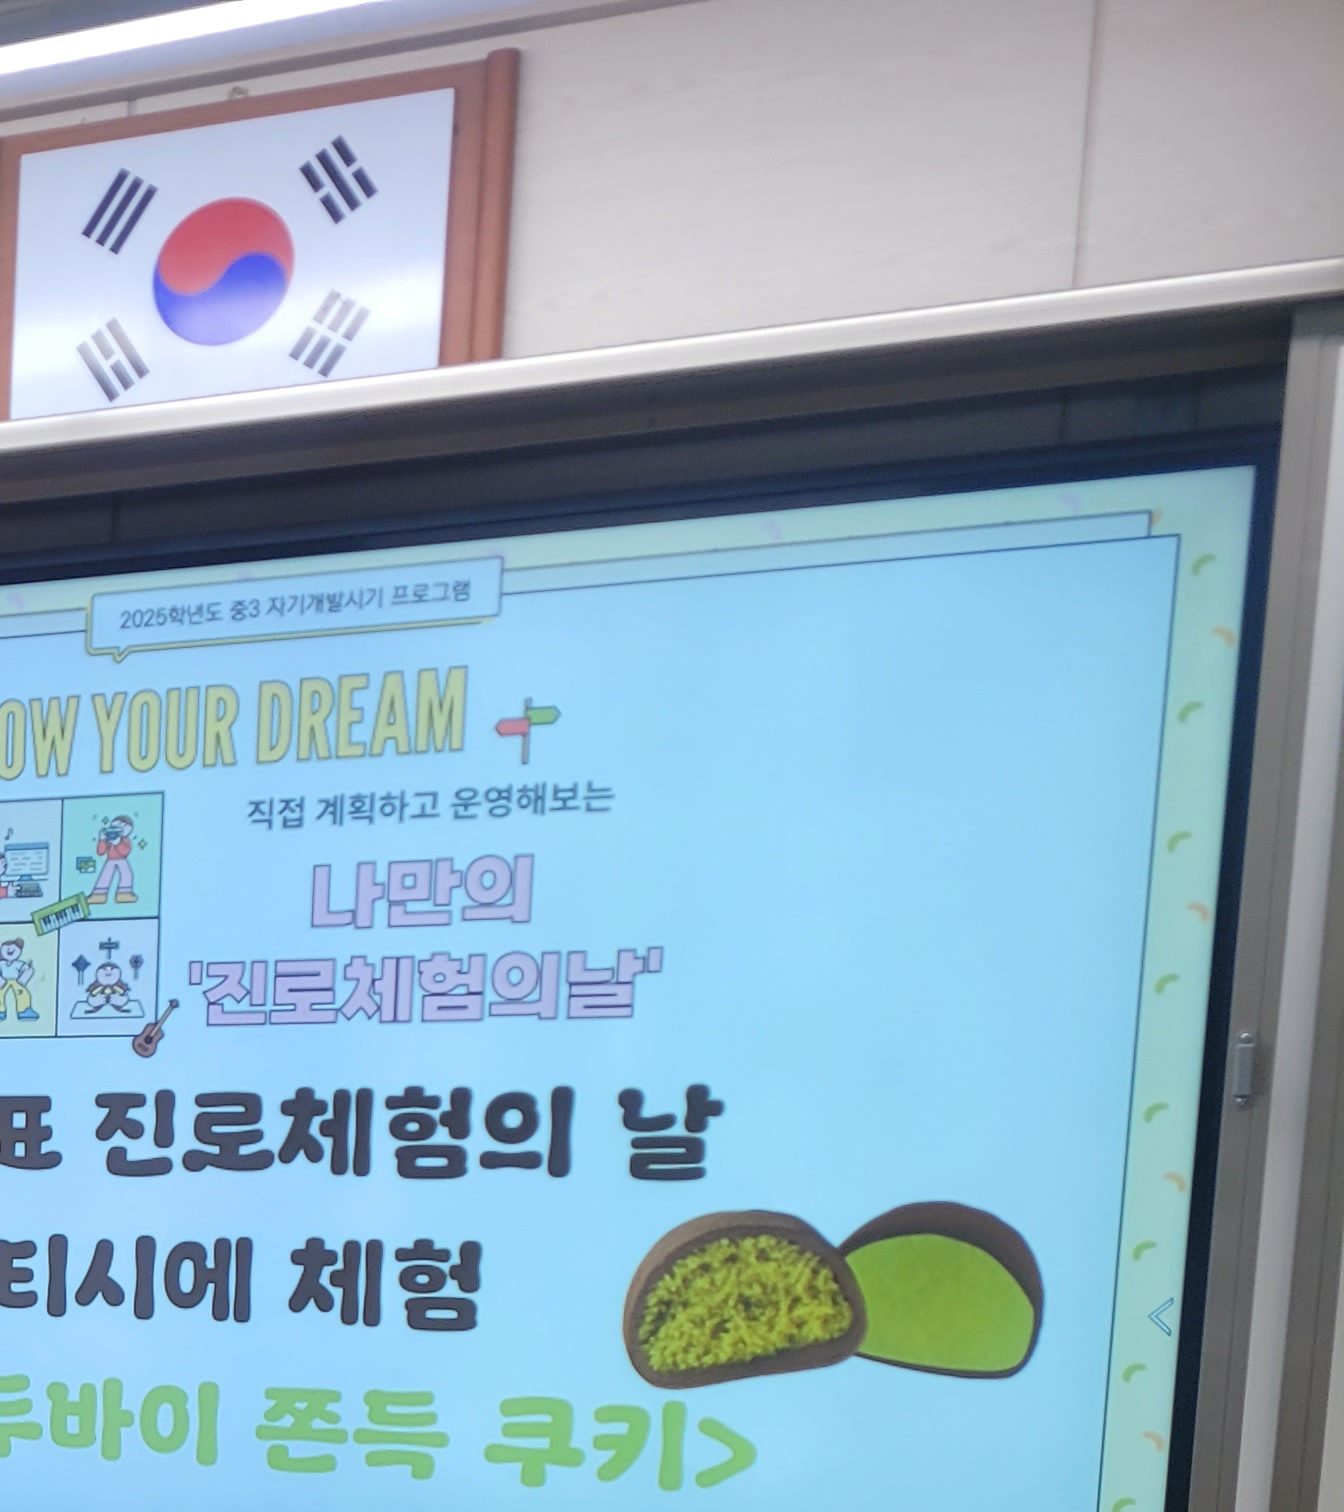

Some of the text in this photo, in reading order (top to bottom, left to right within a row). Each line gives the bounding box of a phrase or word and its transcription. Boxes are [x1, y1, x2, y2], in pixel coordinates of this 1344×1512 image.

[119, 579, 471, 631] 2025학년도 중3 자기개발시기 프로그램
[93, 684, 240, 774] YOUR
[256, 665, 468, 764] DREAM
[246, 780, 616, 830] 직접 계획하고 운영해보는
[310, 853, 535, 929] 나만의
[94, 1083, 576, 1179] 진로체험의
[617, 1083, 725, 1182] 날
[287, 1237, 483, 1333] 체험
[254, 1386, 450, 1481] 쫀득
[483, 1395, 758, 1493] 쿠키>
